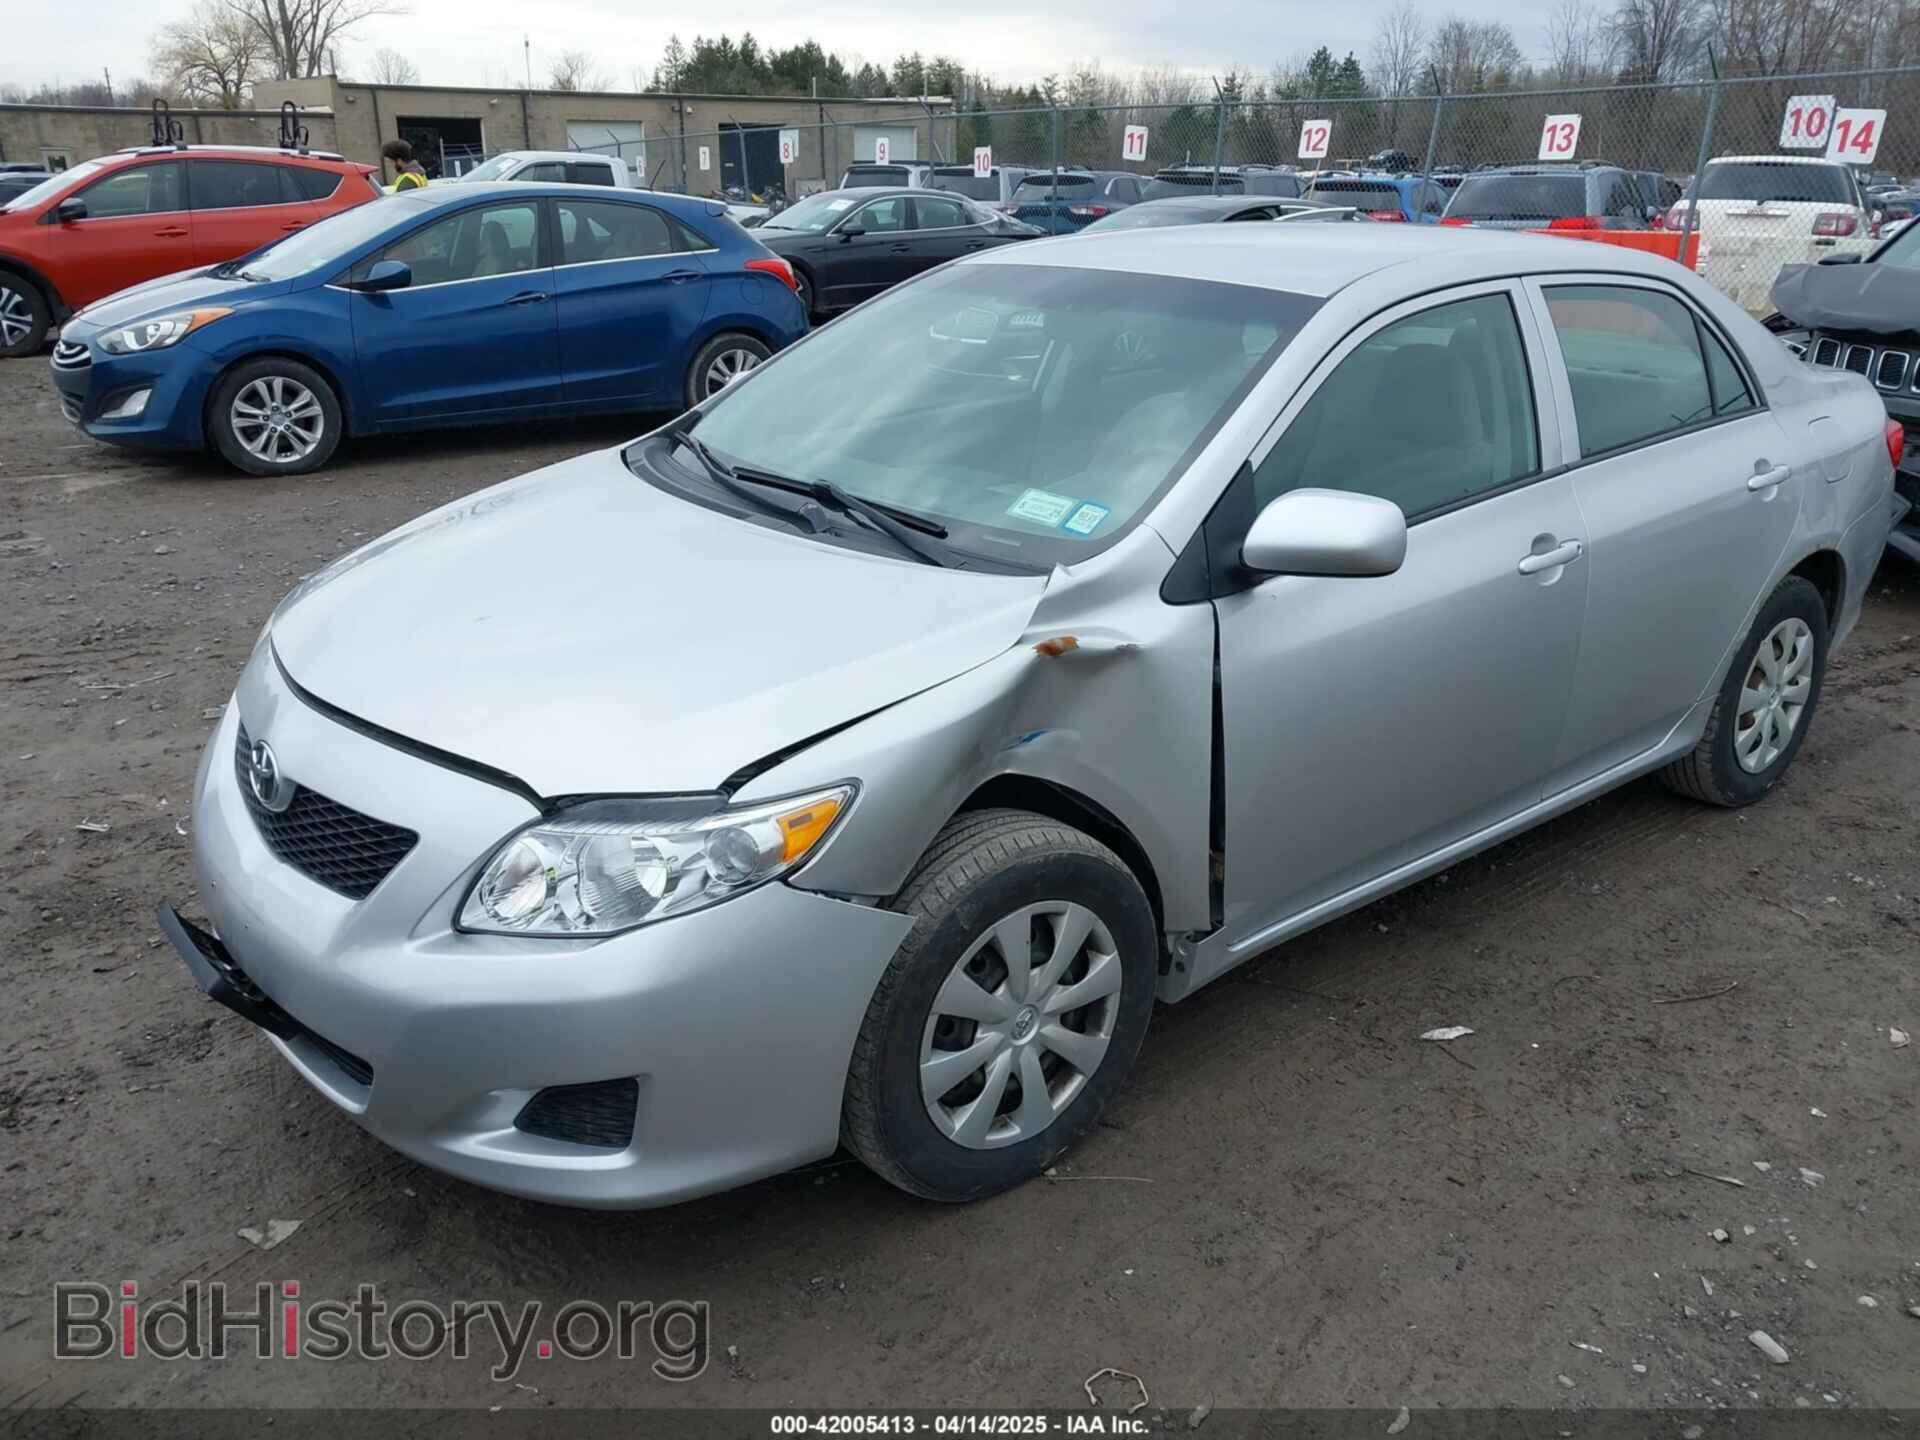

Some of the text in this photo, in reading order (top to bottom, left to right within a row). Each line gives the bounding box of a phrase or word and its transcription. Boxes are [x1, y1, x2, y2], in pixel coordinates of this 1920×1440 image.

[1790, 106, 1827, 138] 10
[1127, 132, 1145, 155] 11
[1303, 127, 1328, 152] 12
[1546, 122, 1576, 153] 13
[1836, 119, 1876, 154] 14
[783, 142, 790, 160] 8
[879, 142, 886, 161] 9
[975, 153, 990, 171] 10
